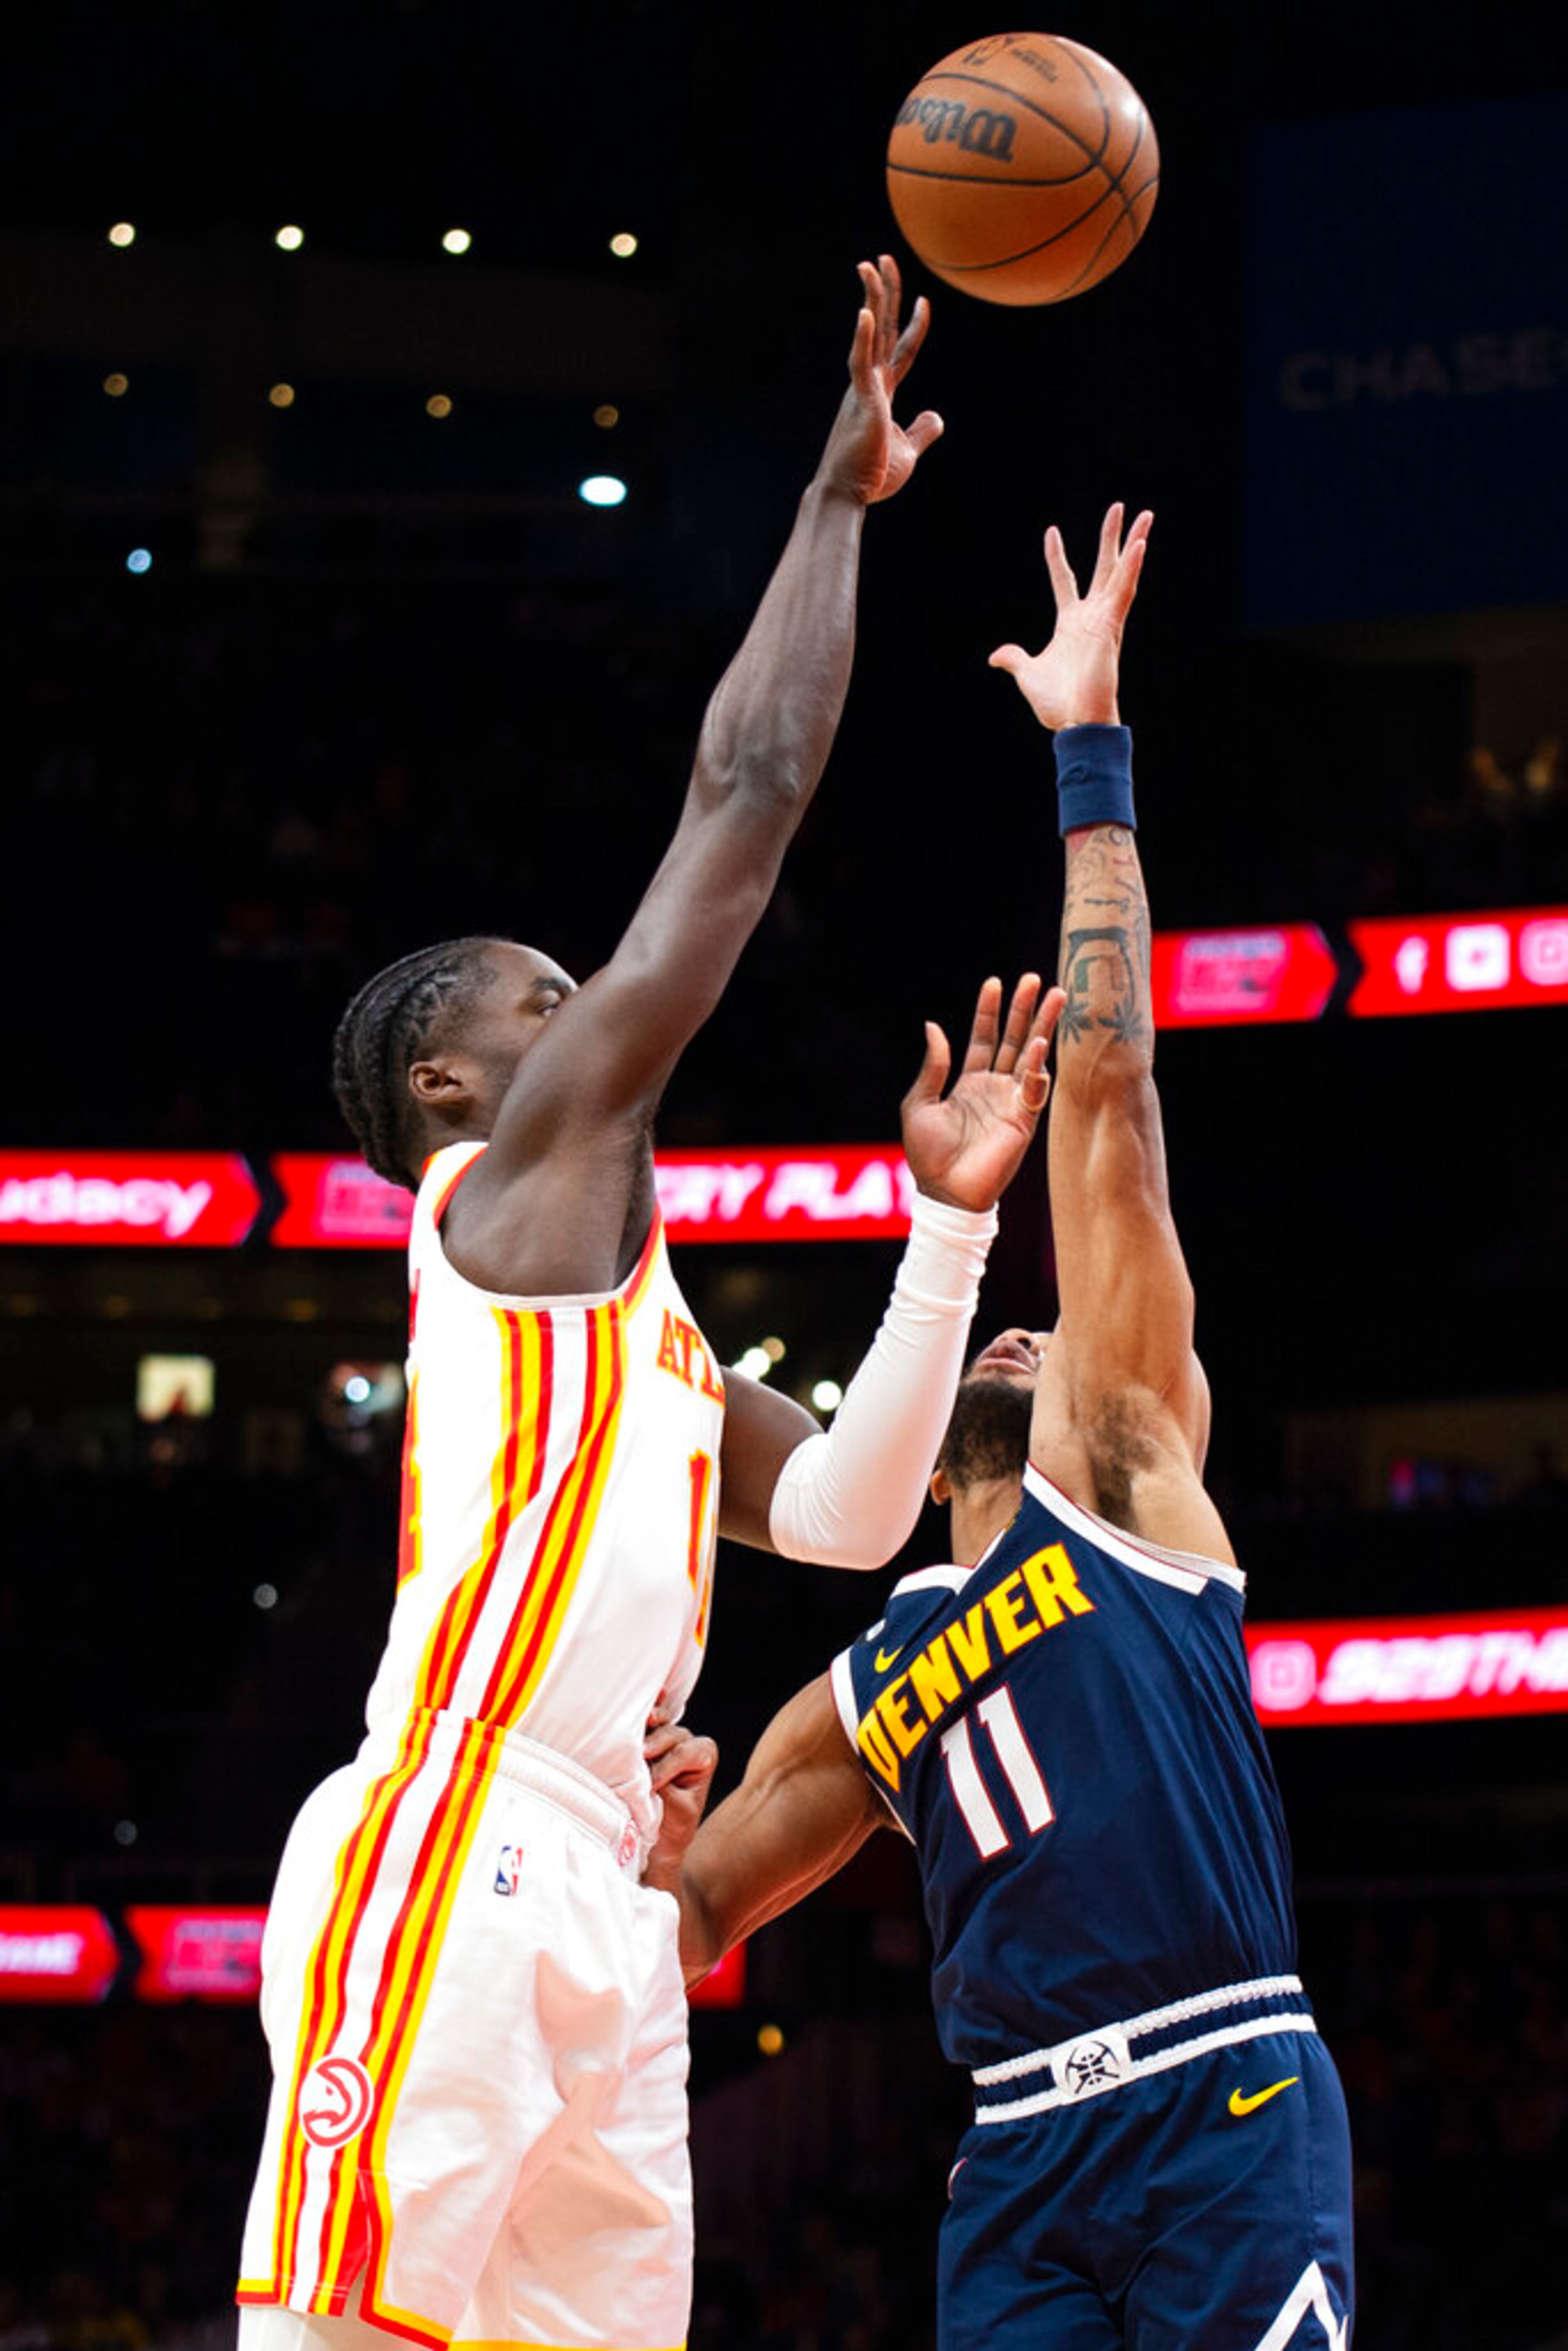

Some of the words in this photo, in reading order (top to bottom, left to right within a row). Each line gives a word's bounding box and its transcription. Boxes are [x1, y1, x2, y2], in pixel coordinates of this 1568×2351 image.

[896, 97, 1017, 163] Wilso
[1277, 327, 1555, 412] CHASE
[857, 1540, 1096, 1793] DENVER
[940, 1682, 1056, 1862] 11
